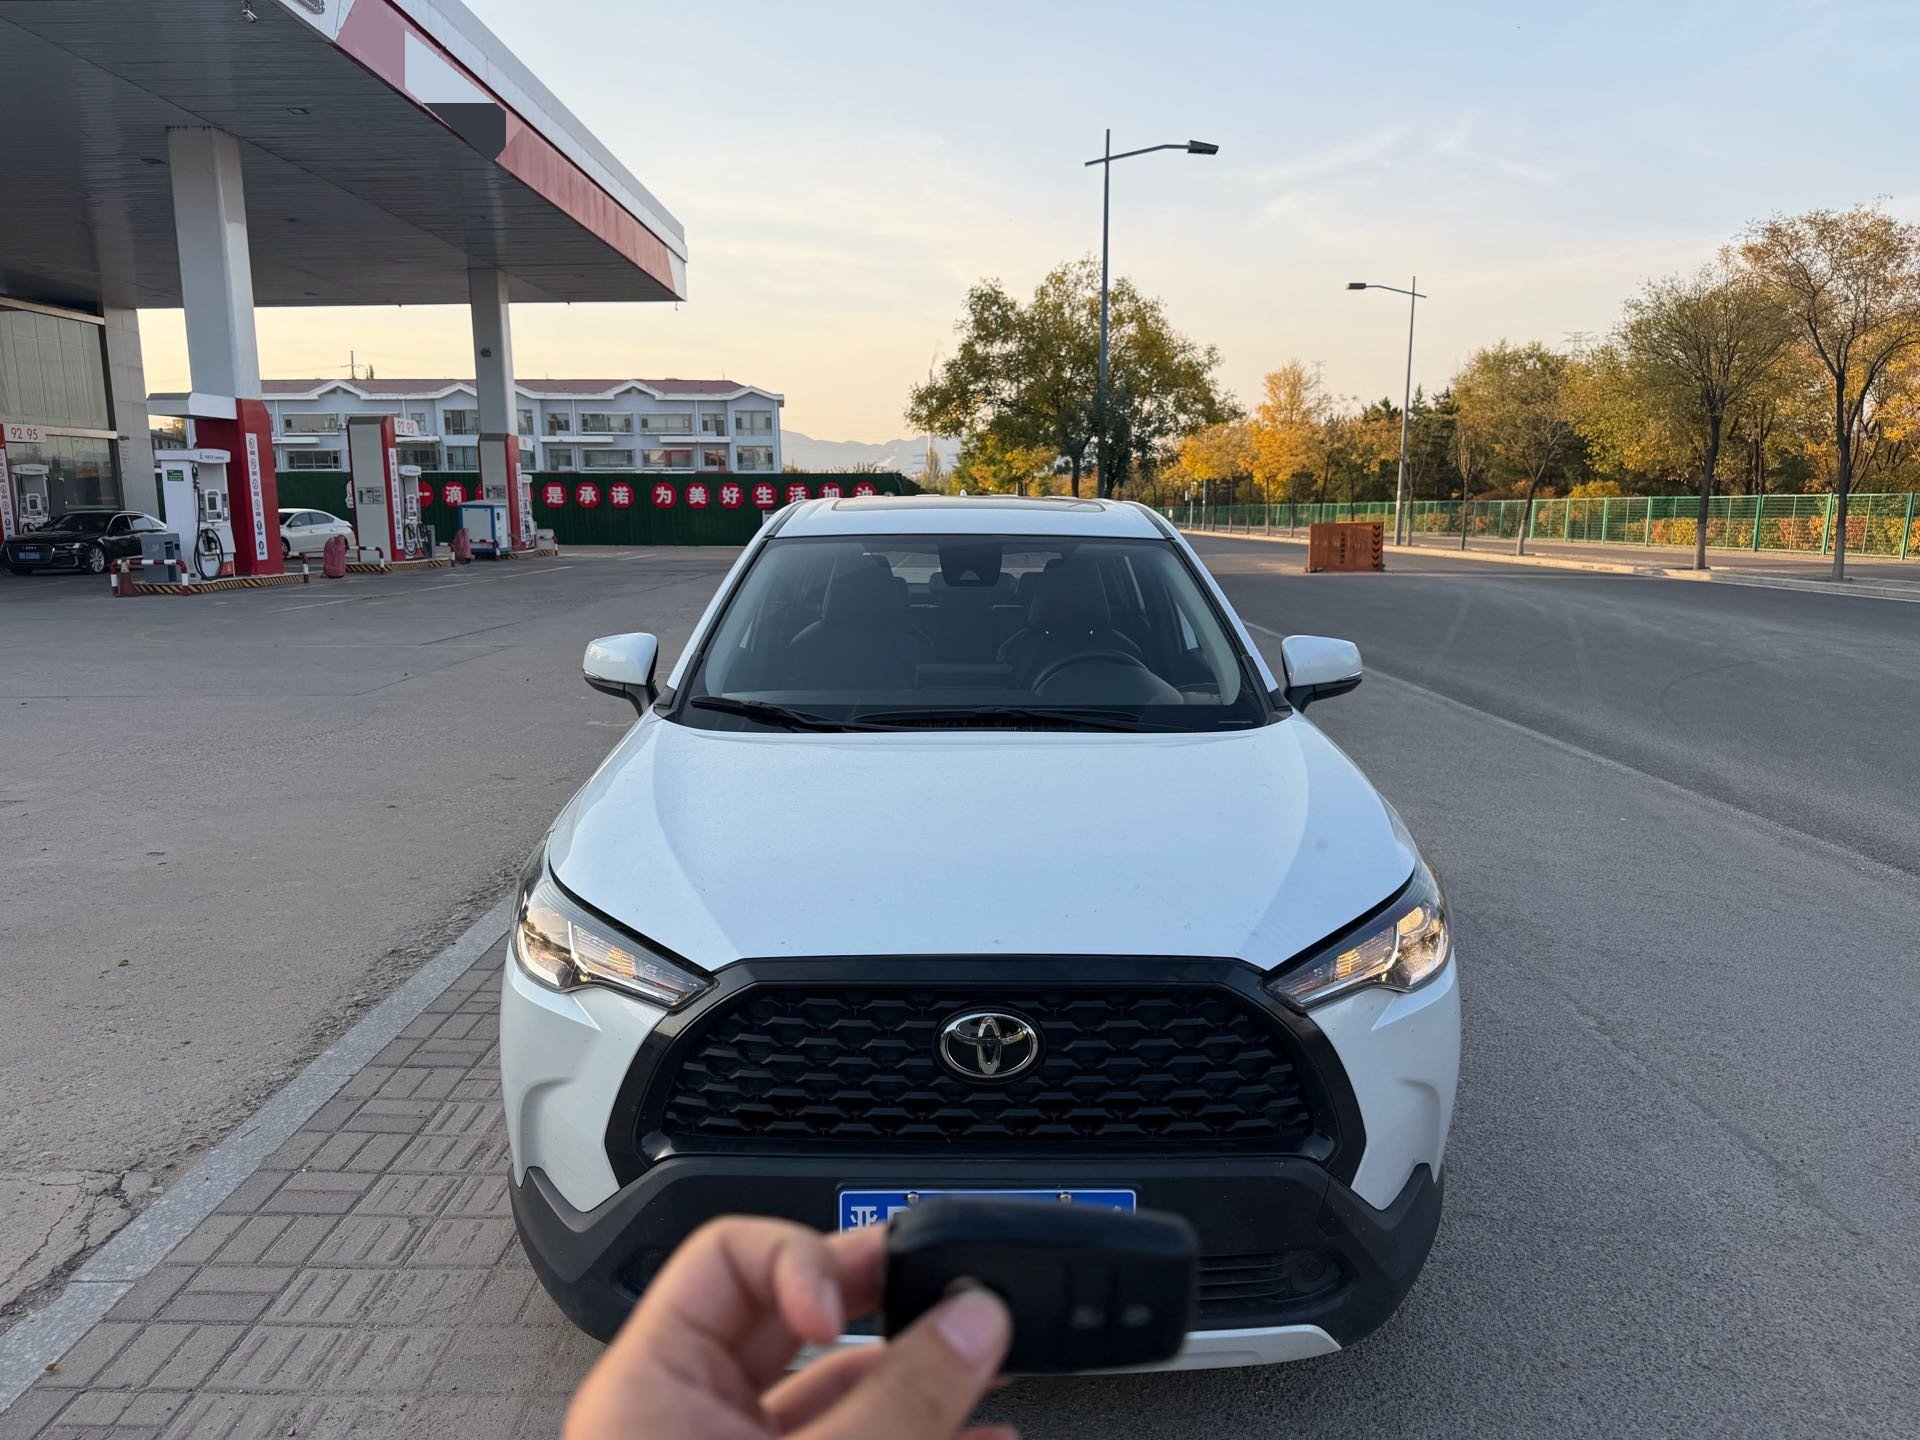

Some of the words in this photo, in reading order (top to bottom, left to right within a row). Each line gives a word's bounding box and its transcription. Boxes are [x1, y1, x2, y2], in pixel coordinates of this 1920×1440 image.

[10, 427, 23, 440] 92
[27, 428, 39, 441] 95
[397, 420, 405, 433] 92
[406, 422, 414, 434] 95
